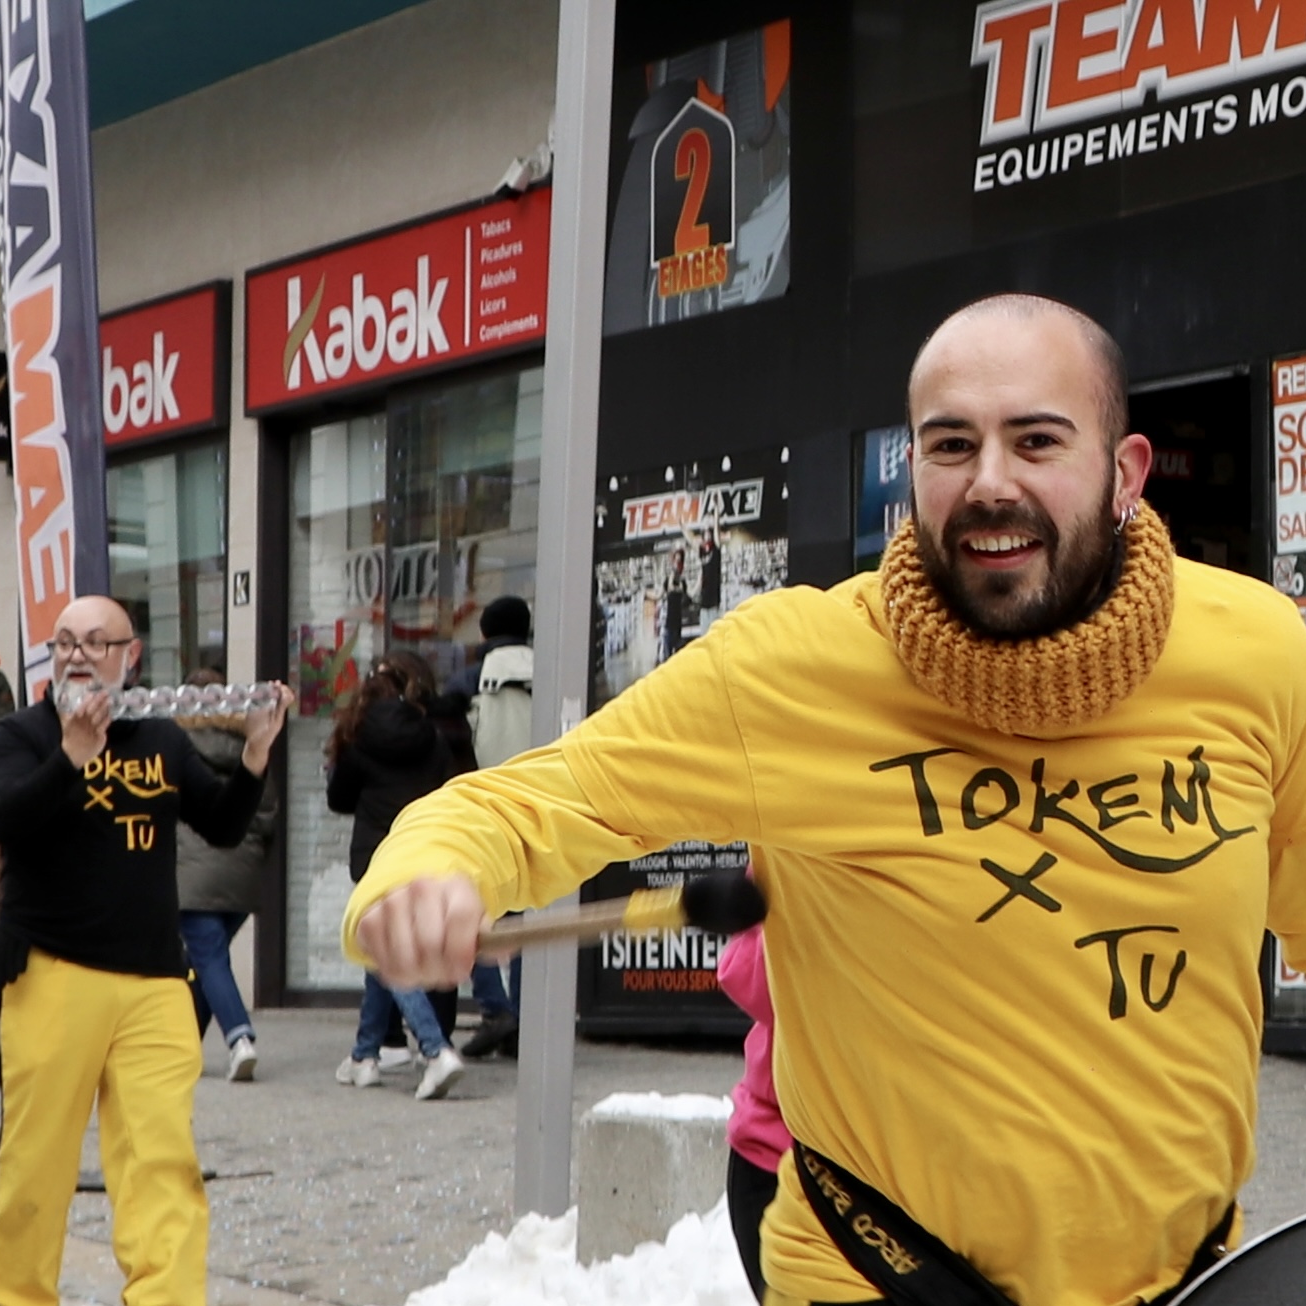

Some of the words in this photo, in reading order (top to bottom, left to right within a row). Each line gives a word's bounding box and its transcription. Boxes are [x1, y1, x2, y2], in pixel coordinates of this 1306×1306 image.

[974, 92, 1238, 191] EQUIPEMENTS
[674, 127, 711, 256] 2
[657, 243, 728, 298] ETAGES
[283, 255, 449, 390] Kabak
[479, 313, 538, 342] Complements
[83, 750, 178, 798] OKEM
[869, 745, 1258, 874] TOKEM
